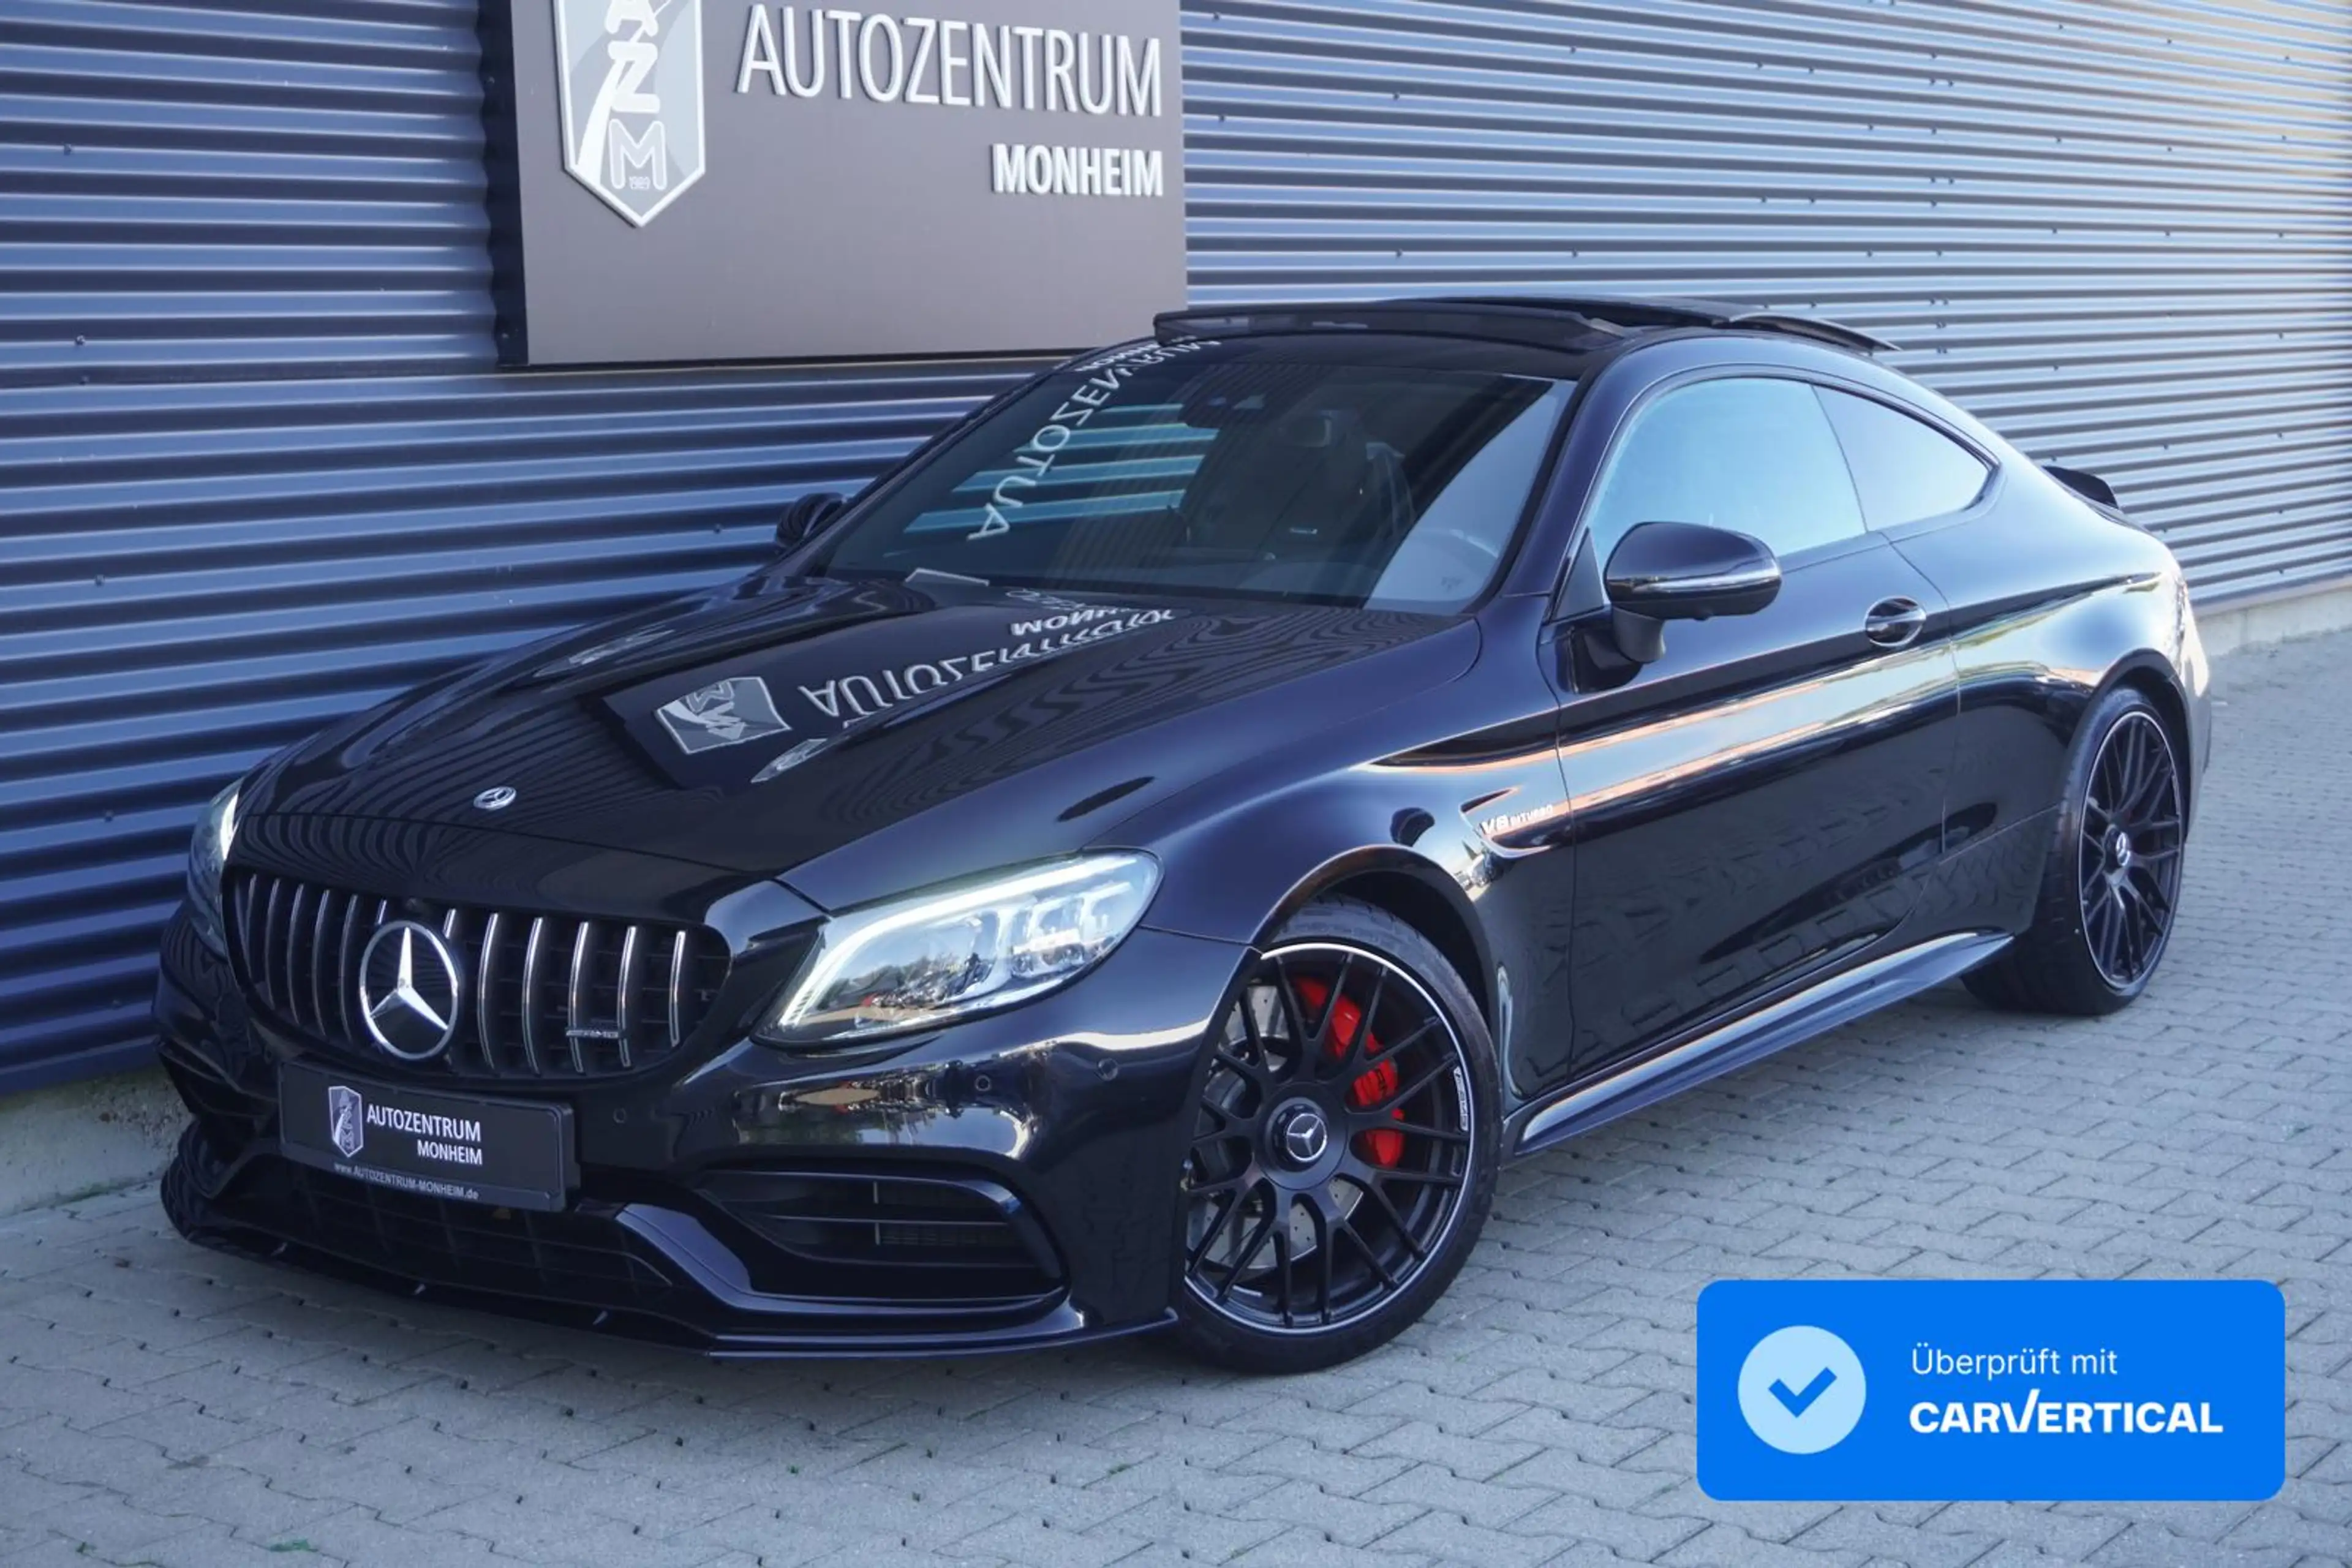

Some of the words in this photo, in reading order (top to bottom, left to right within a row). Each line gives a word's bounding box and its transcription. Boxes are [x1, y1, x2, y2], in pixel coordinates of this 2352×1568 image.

[736, 4, 1162, 117] AUTOZENTRUM
[991, 143, 1163, 197] MONHEIM
[366, 1103, 481, 1143] AUTOZENTRUM
[417, 1139, 483, 1166] MONHEIM
[333, 1162, 480, 1200] www.AUTOZENTRUM-MONHEIM.de
